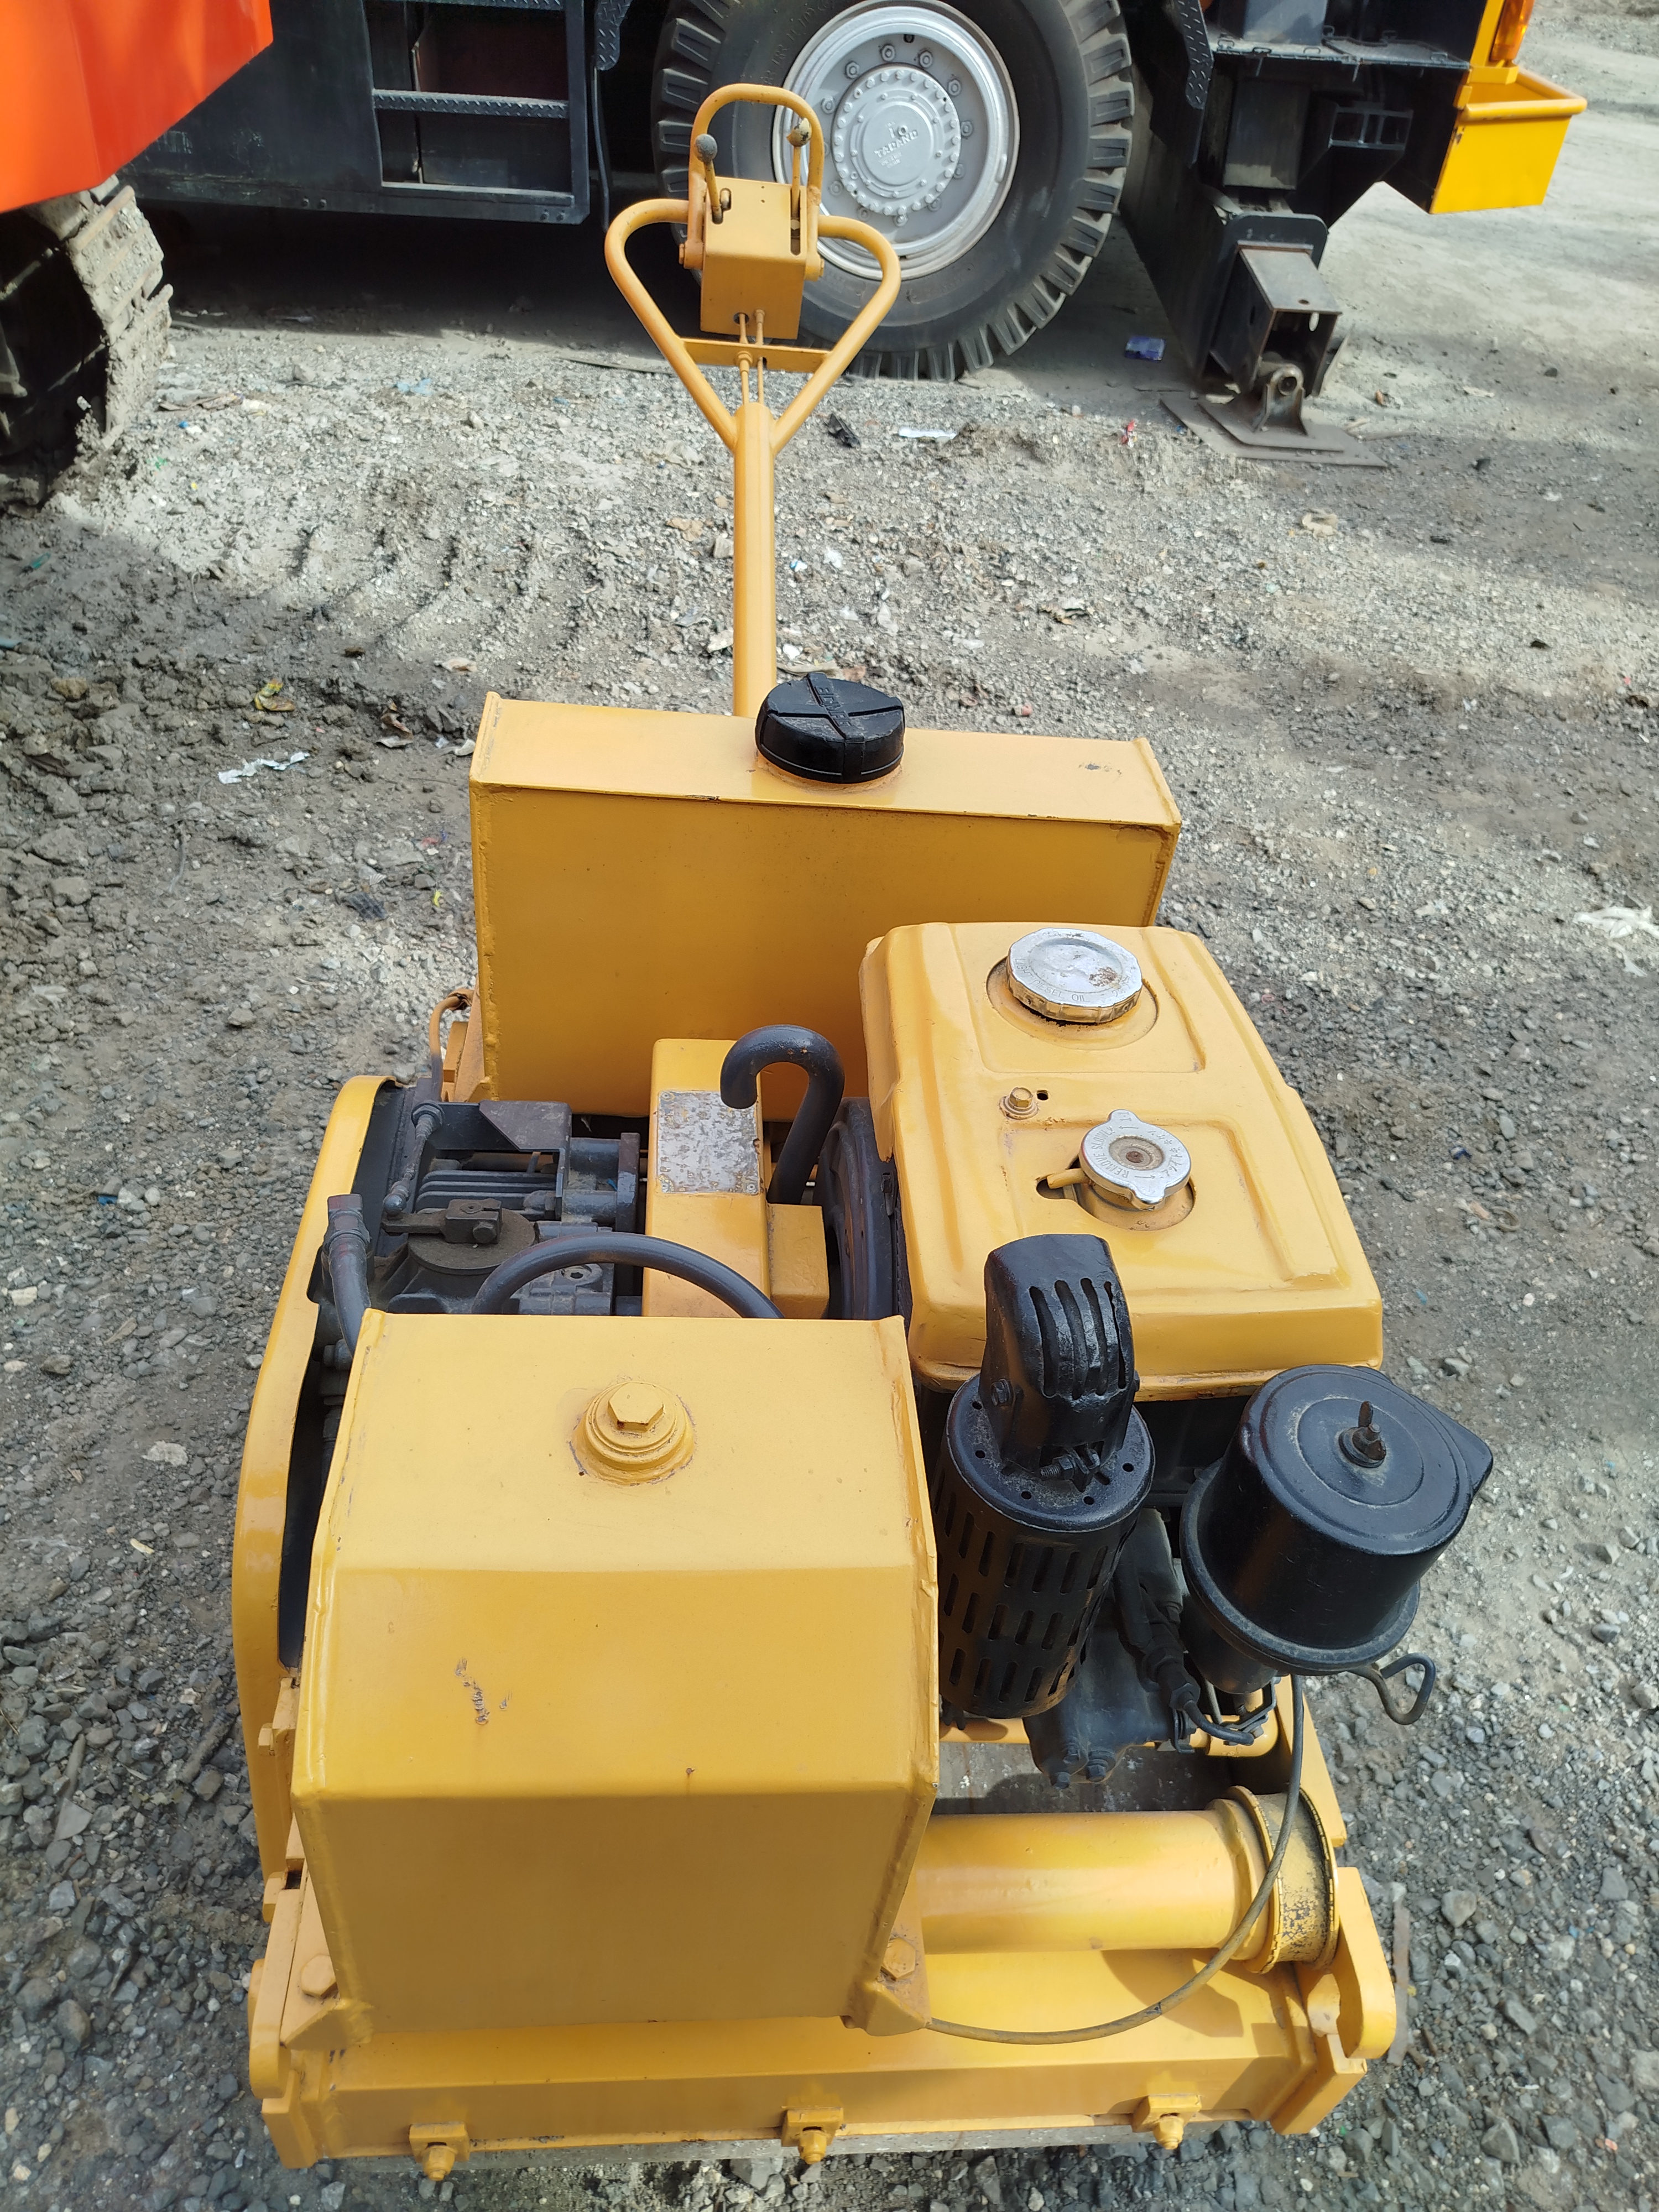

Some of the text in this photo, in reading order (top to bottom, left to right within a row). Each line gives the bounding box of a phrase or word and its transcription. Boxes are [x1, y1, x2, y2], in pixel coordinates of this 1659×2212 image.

[1015, 958, 1091, 1002] LIGHT DIESEL OIL
[1091, 1125, 1130, 1178] REMOVE SLOWLY
